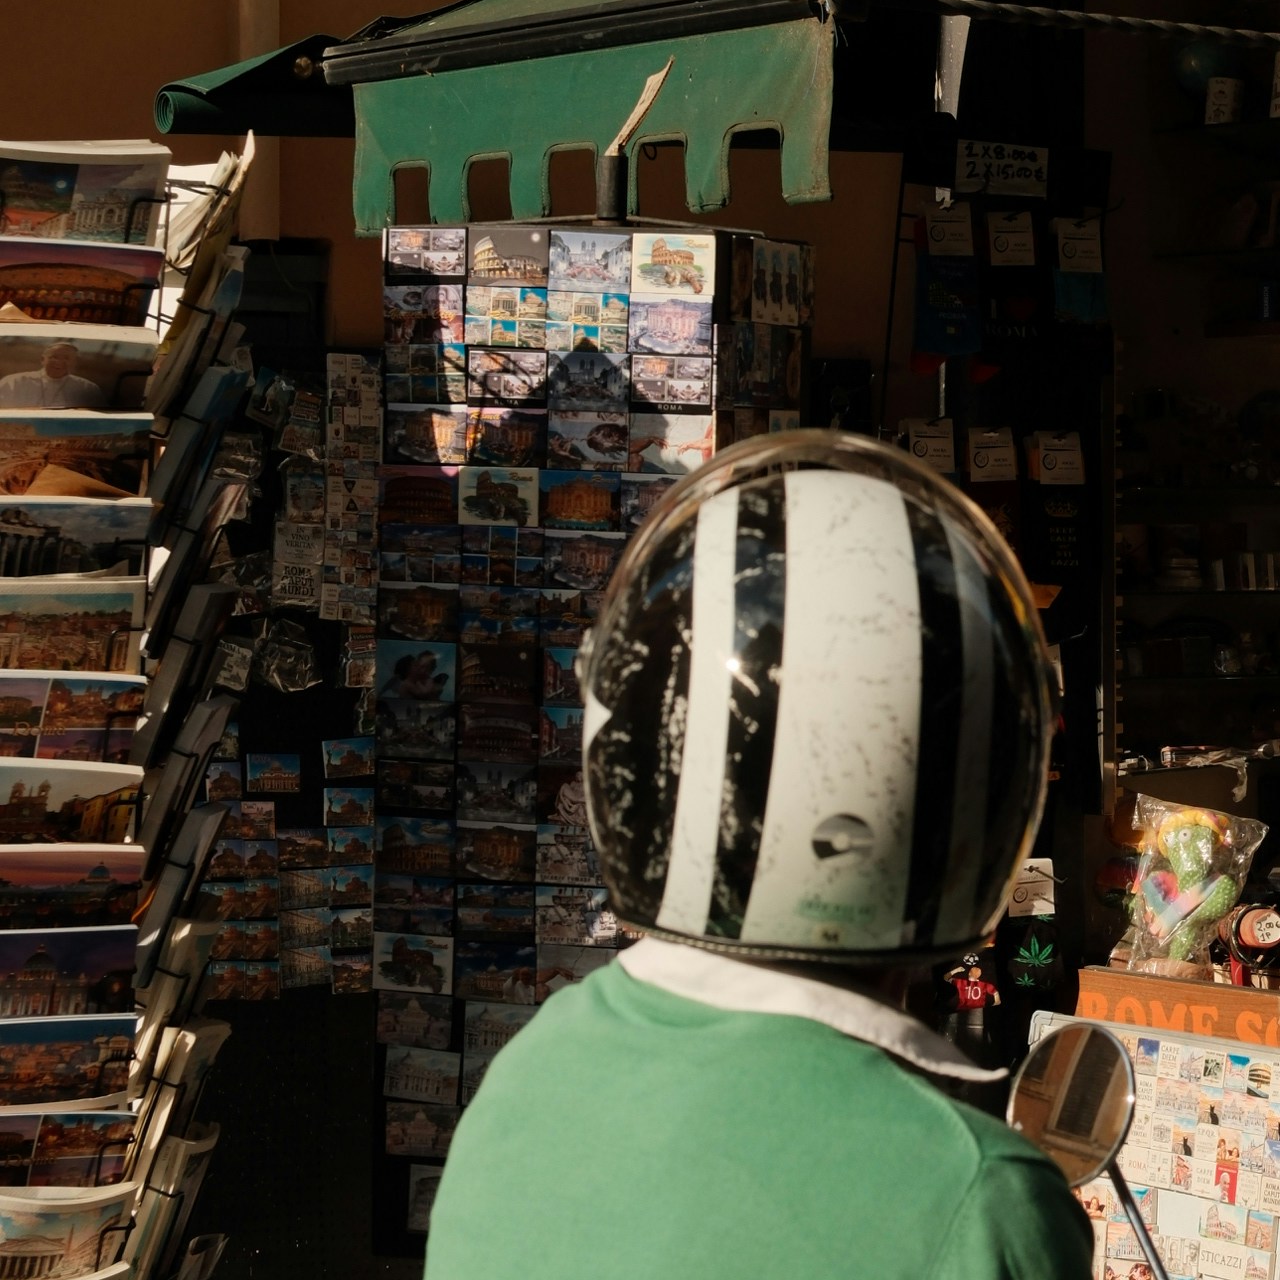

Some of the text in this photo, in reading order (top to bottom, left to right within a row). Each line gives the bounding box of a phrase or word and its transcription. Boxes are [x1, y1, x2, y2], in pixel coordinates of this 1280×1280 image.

[658, 403, 683, 412] ROMA
[297, 526, 306, 534] IN
[291, 533, 310, 542] VINO
[285, 540, 316, 550] VERITAS
[284, 566, 312, 577] ROMA
[282, 576, 314, 588] CAPUT
[280, 586, 316, 598] MUNDI
[964, 986, 981, 1000] 10
[1161, 1045, 1180, 1054] CARPE
[1162, 1054, 1177, 1062] DIEM
[1128, 1159, 1146, 1170] ROMA
[1266, 1182, 1280, 1191] ROMA
[1264, 1190, 1280, 1199] CAPUT
[1262, 1198, 1280, 1208] MUNDI
[1200, 1250, 1242, 1269] STICAZZI
